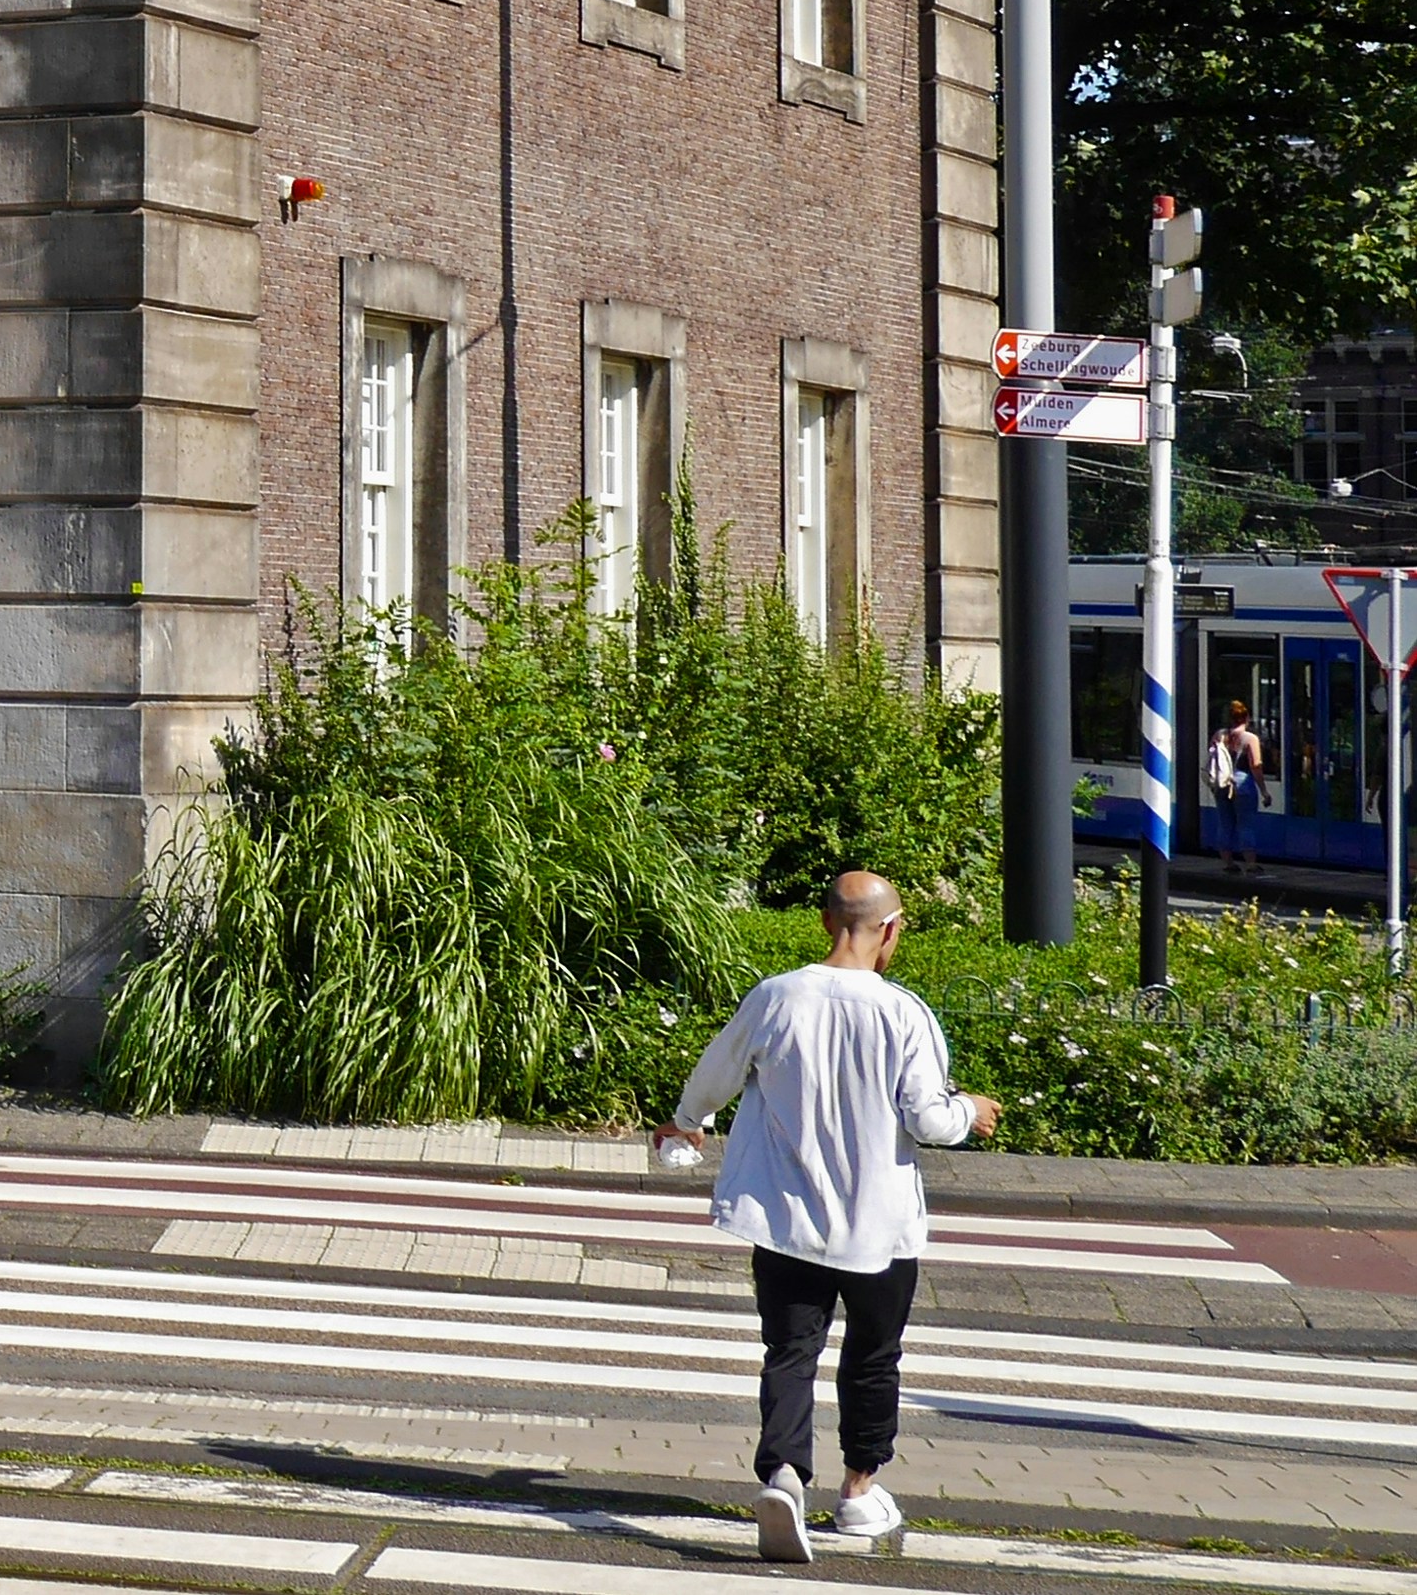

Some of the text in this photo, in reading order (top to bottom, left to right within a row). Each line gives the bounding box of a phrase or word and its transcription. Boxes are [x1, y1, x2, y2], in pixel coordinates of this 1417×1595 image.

[1021, 338, 1082, 356] Zeeburg
[1020, 357, 1136, 378] Schellingwoude
[1020, 394, 1074, 411] Muiden
[1020, 415, 1071, 430] Almere
